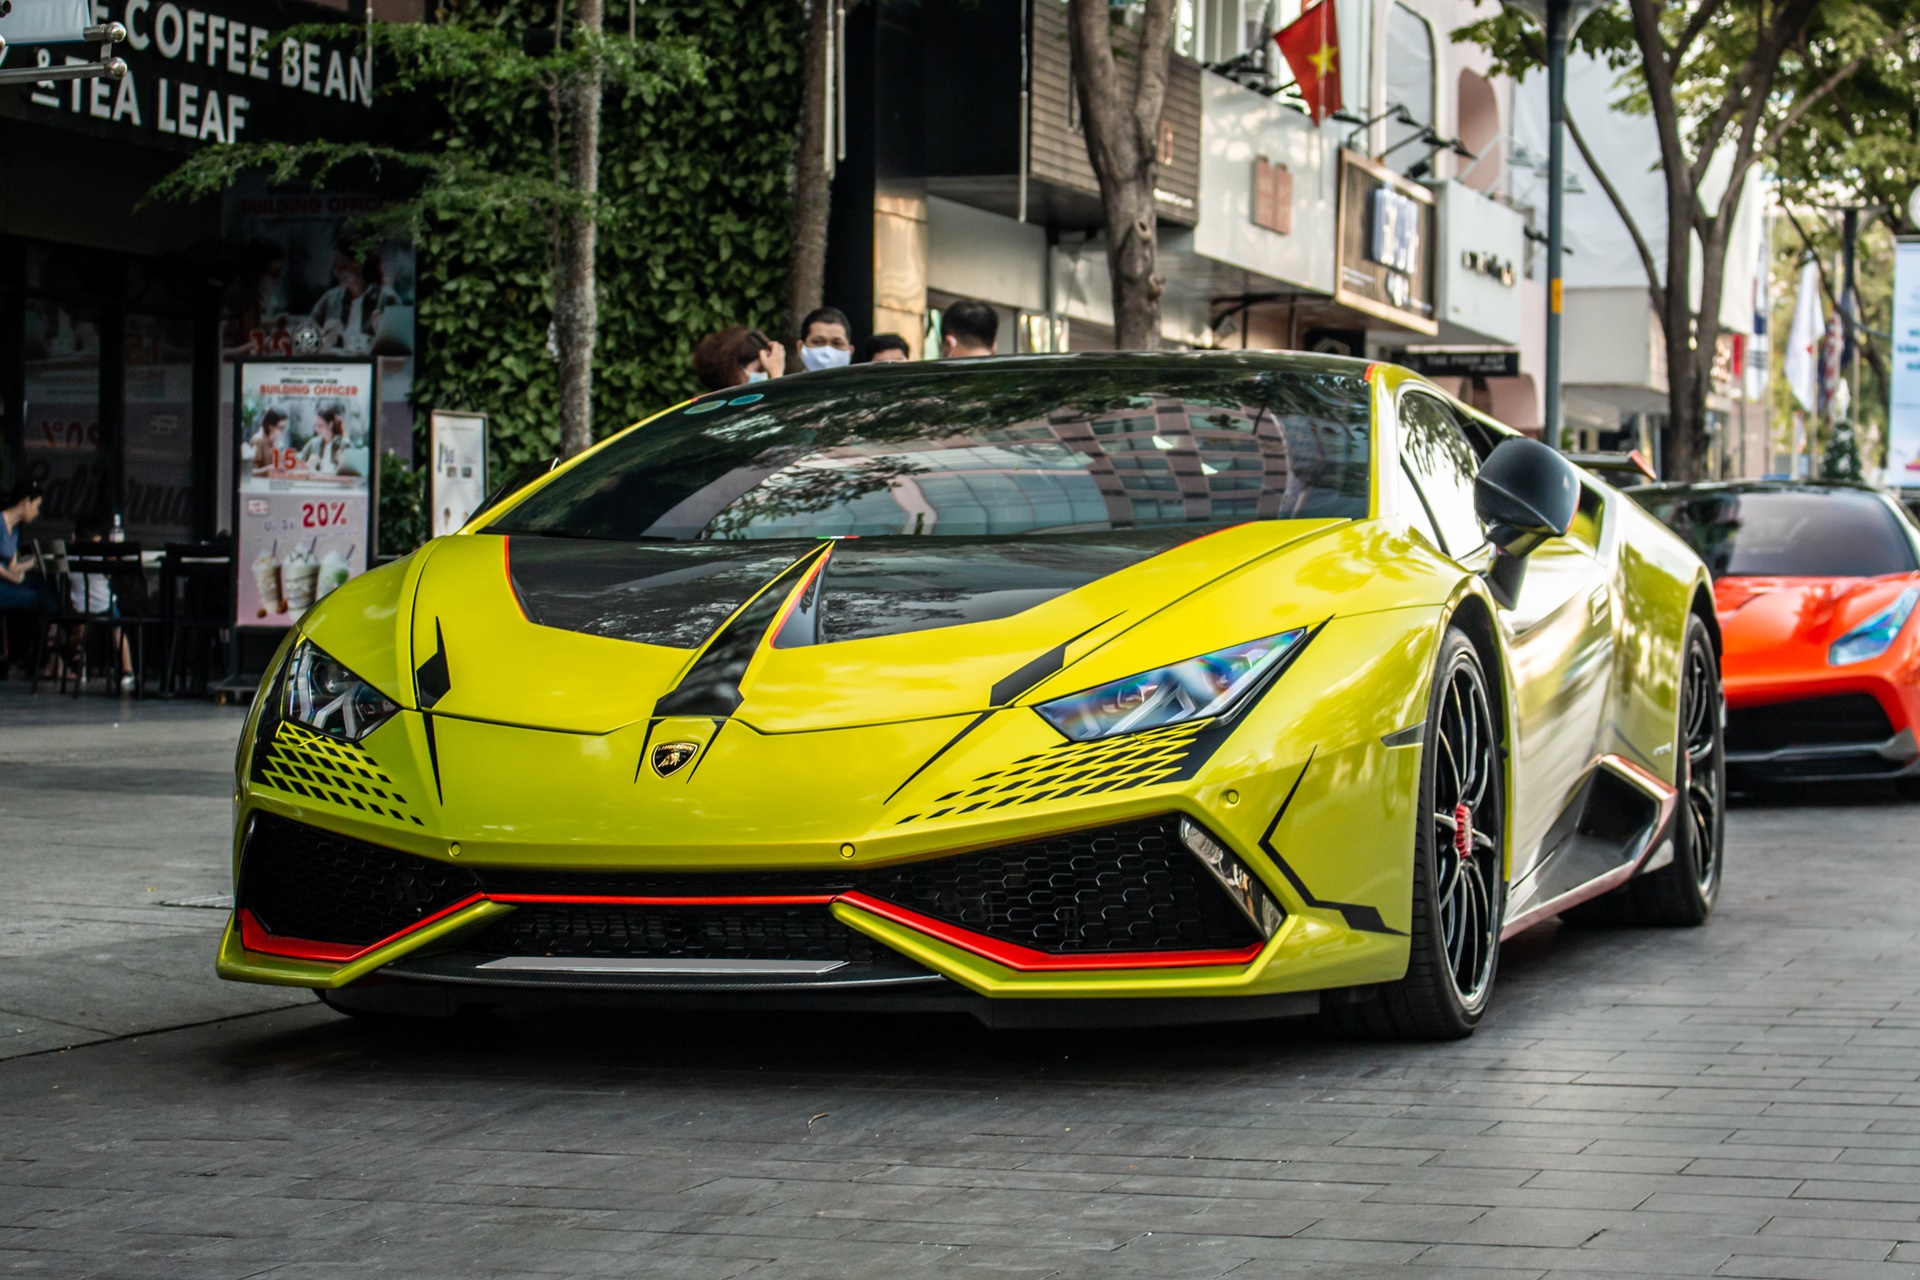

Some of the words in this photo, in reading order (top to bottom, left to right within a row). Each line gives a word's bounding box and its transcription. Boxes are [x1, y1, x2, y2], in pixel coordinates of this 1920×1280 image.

[125, 0, 269, 80] COFFEE
[282, 36, 373, 108] BEAN
[65, 55, 141, 126] TEA
[158, 78, 250, 144] LEAF
[259, 384, 310, 396] BUILDING
[313, 384, 358, 396] OFFICER
[302, 501, 347, 528] 20%
